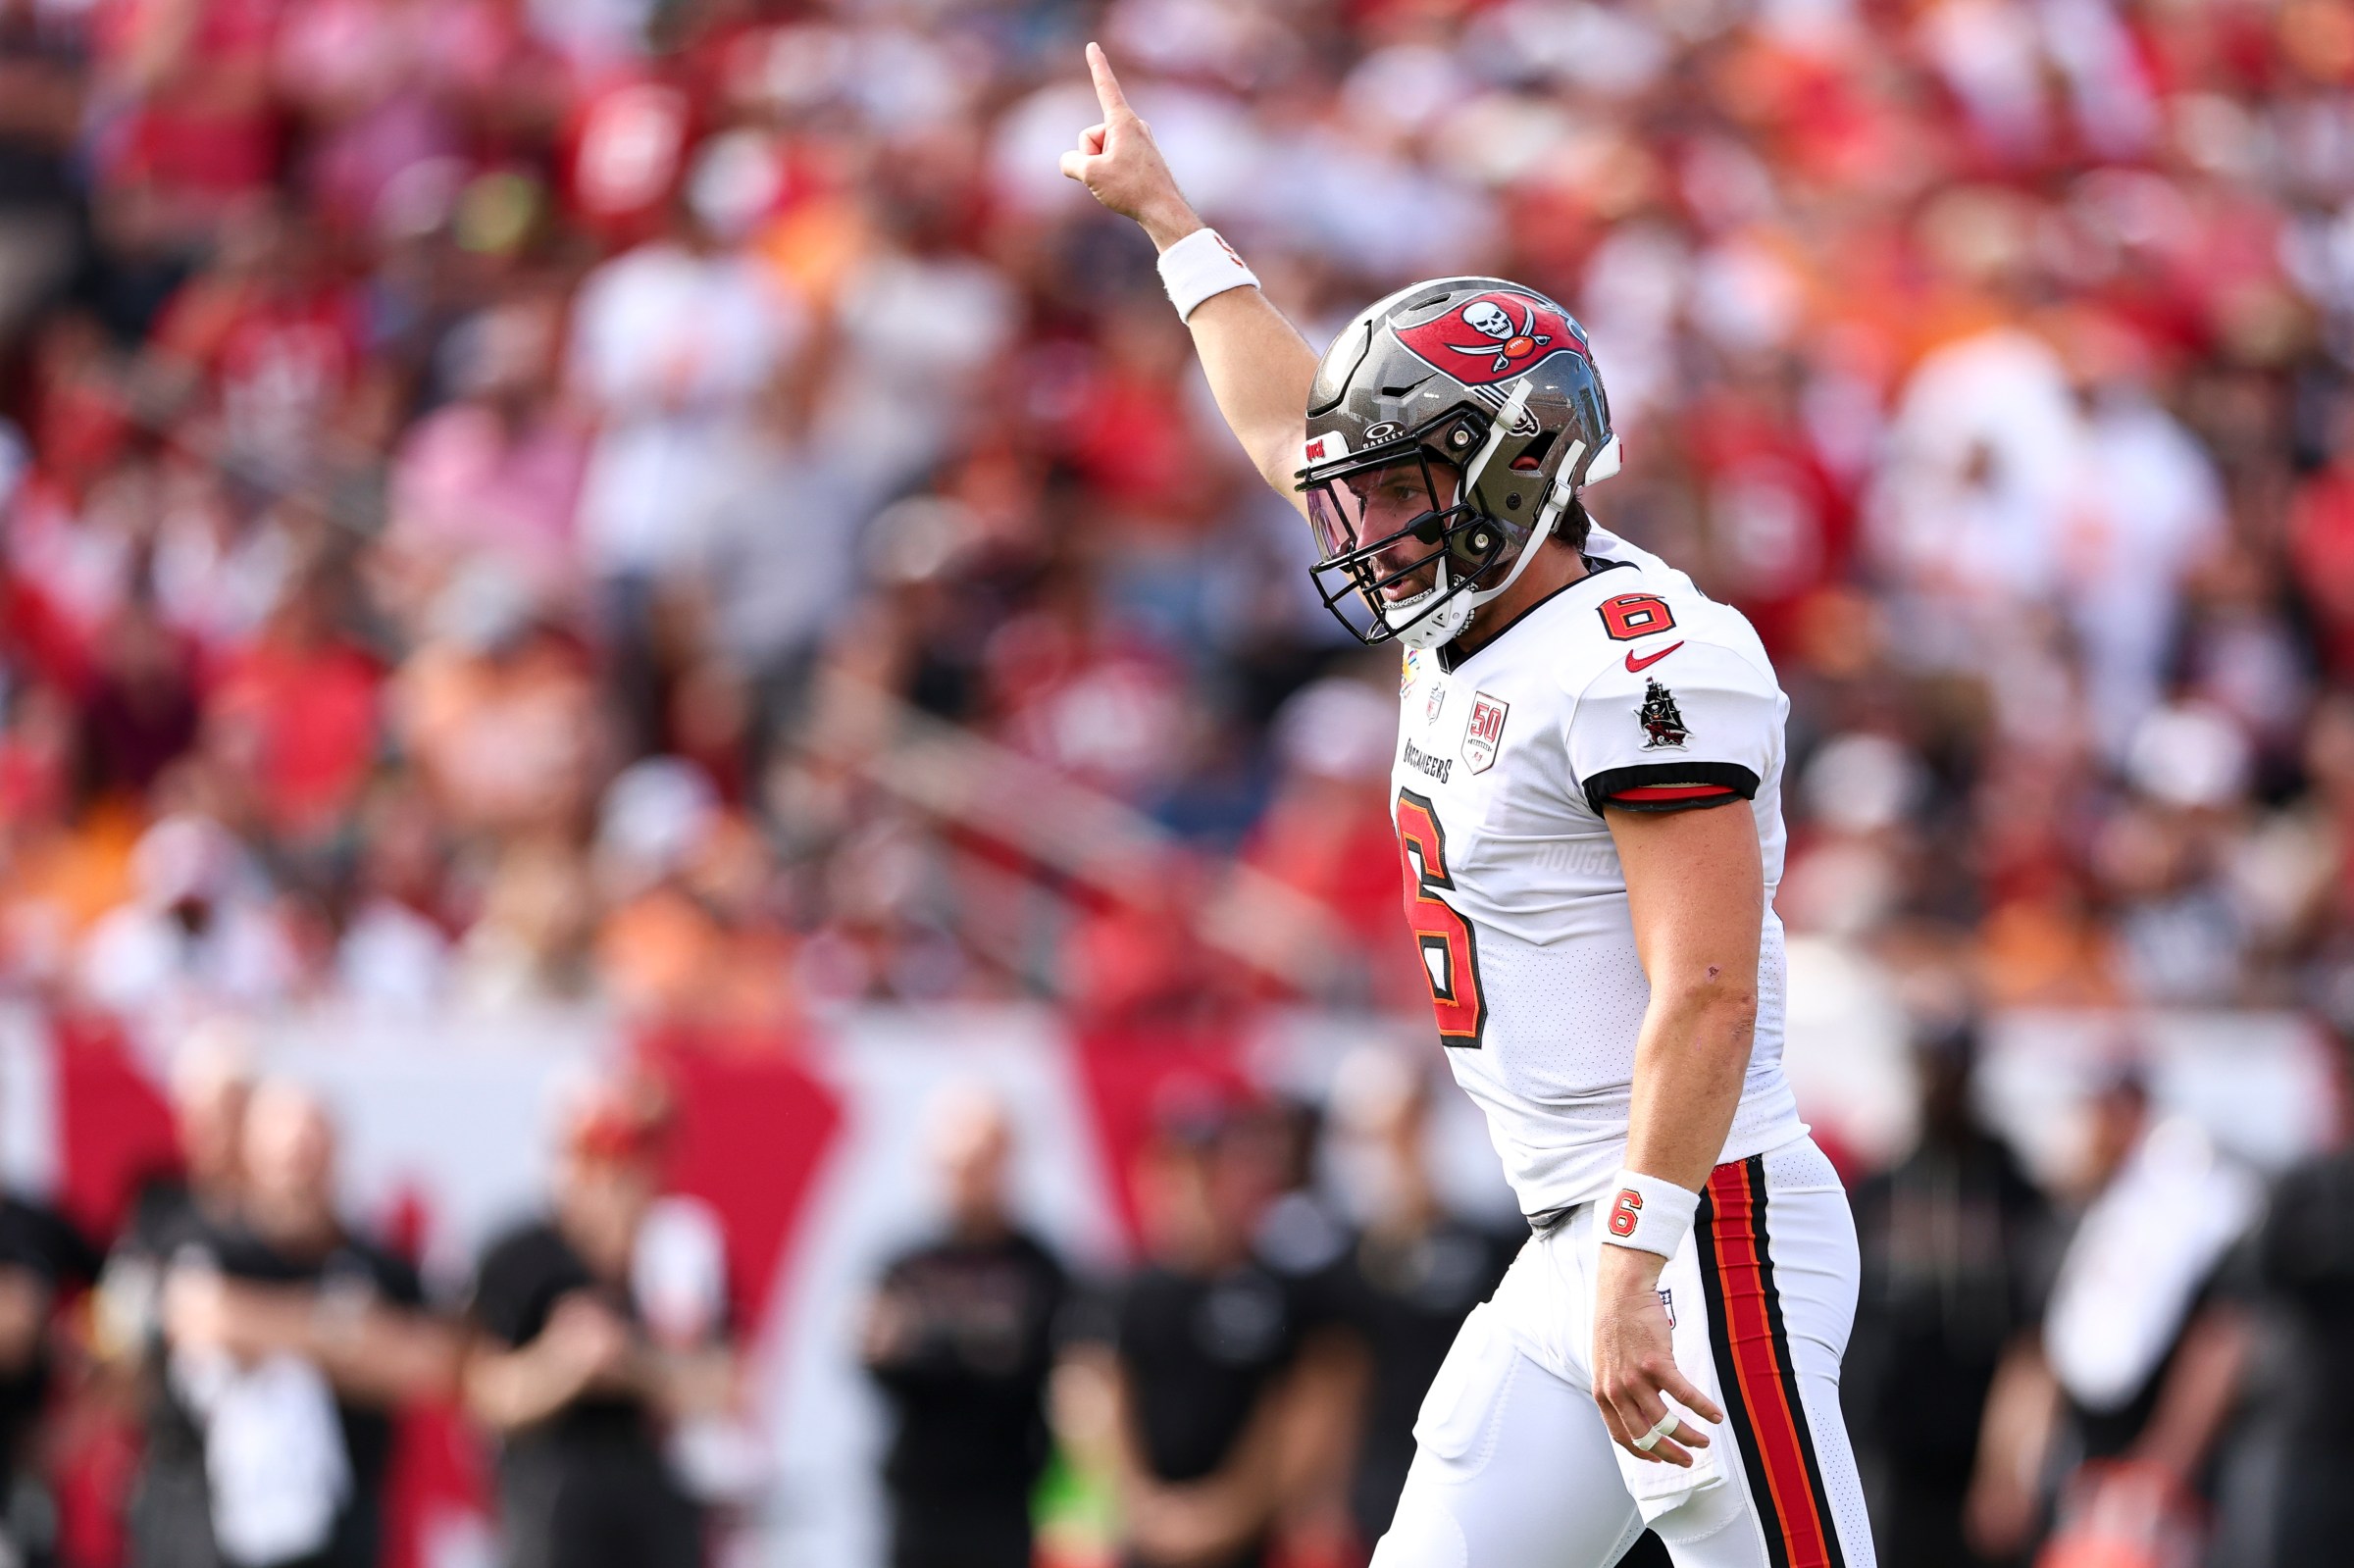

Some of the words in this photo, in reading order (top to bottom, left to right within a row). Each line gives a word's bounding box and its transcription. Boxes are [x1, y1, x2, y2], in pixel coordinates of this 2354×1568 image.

[1362, 430, 1405, 449] OAKLEY
[1595, 593, 1676, 641] 6
[1470, 701, 1502, 743] 50
[1403, 737, 1453, 784] BUCCANEERS
[1397, 785, 1488, 1049] 6
[1608, 1188, 1643, 1238] 6
